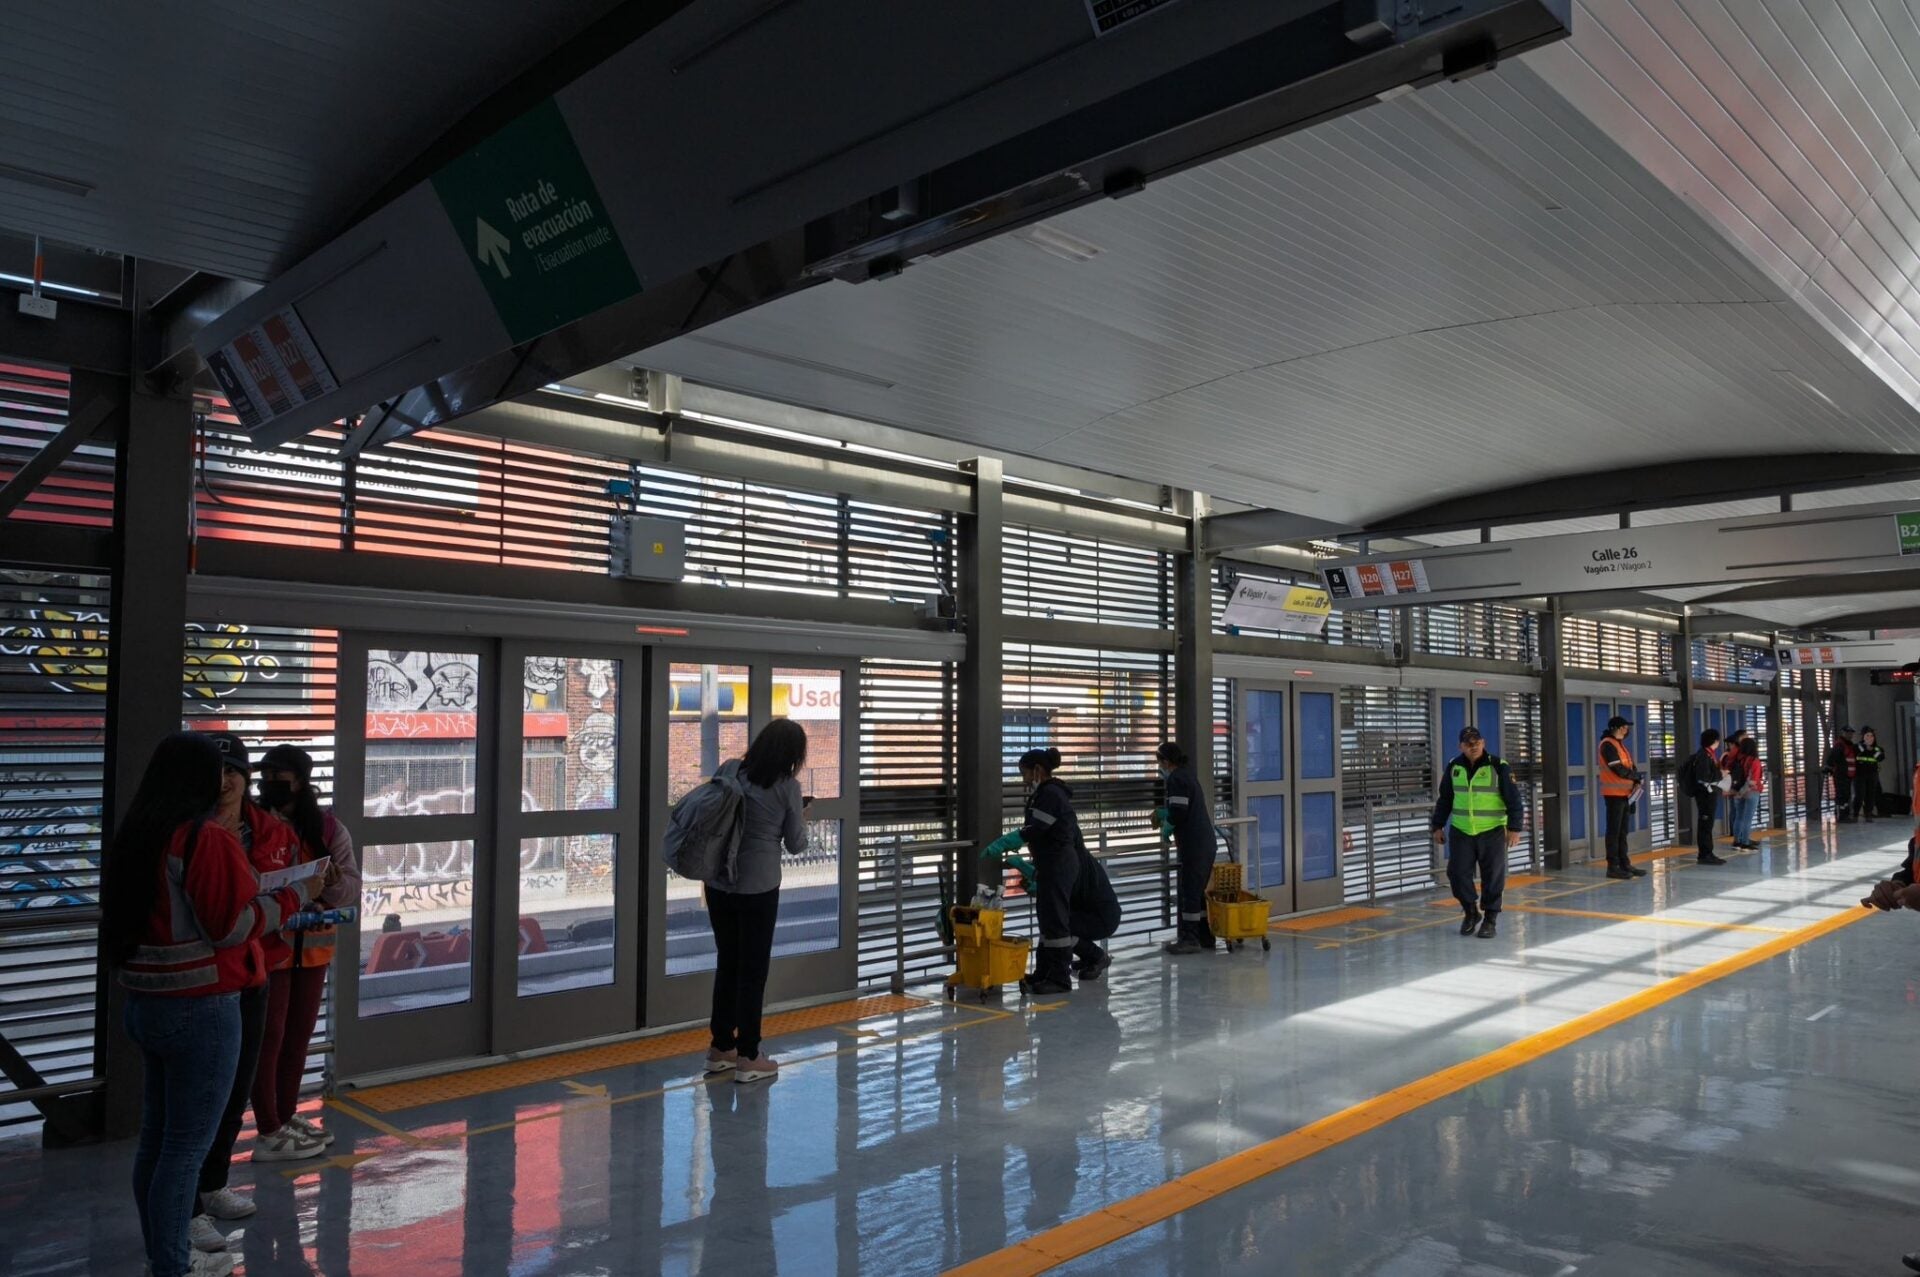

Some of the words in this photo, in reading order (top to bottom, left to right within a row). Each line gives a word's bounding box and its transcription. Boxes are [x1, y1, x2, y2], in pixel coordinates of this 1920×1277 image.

[505, 192, 541, 223] Ruta
[537, 179, 559, 207] de
[522, 197, 594, 250] evacuación
[584, 225, 612, 249] route
[1900, 524, 1920, 537] B2
[1592, 549, 1620, 561] Calle
[1622, 547, 1638, 559] 26
[1393, 570, 1411, 581] H27
[1583, 564, 1609, 576] Vagón
[1610, 564, 1616, 572] 2
[1620, 561, 1646, 573] Wagon
[1646, 561, 1653, 569] 2
[1332, 573, 1340, 584] 8
[1360, 573, 1379, 584] H20
